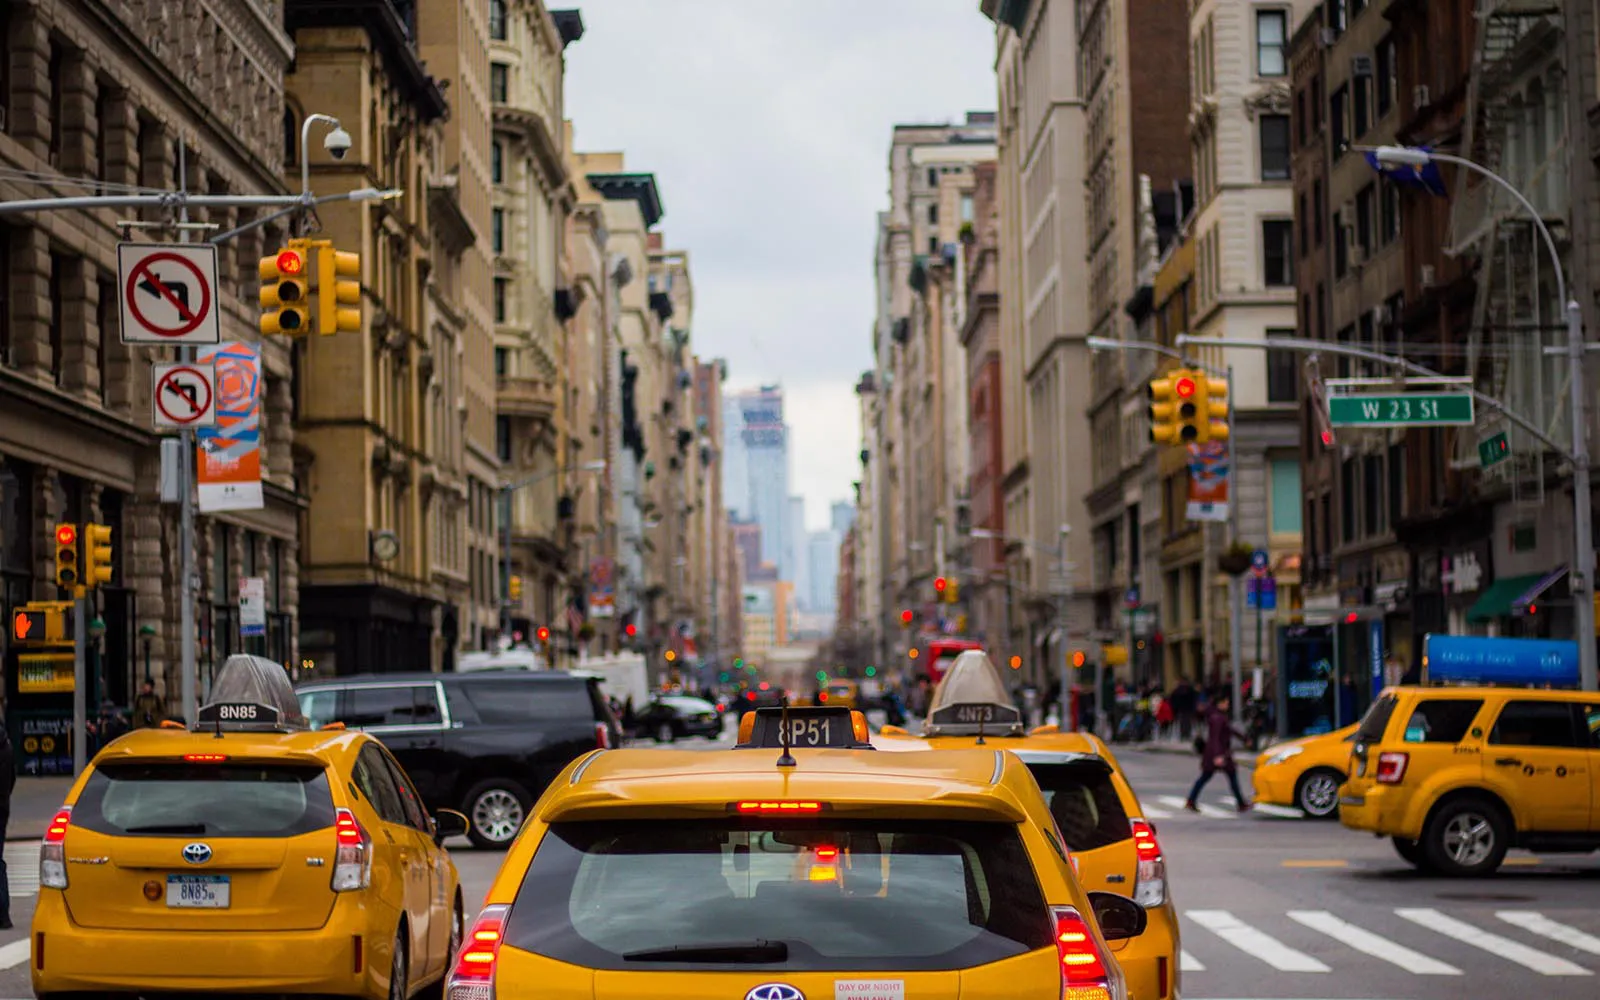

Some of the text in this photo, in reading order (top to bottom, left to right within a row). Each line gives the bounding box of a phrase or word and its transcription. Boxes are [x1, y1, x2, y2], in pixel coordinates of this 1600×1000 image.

[1361, 399, 1439, 420] W 23 St
[219, 705, 257, 719] 8N85
[778, 718, 830, 746] 8P51
[181, 883, 208, 900] 8N85
[838, 983, 900, 992] DAY OR NIGHT
